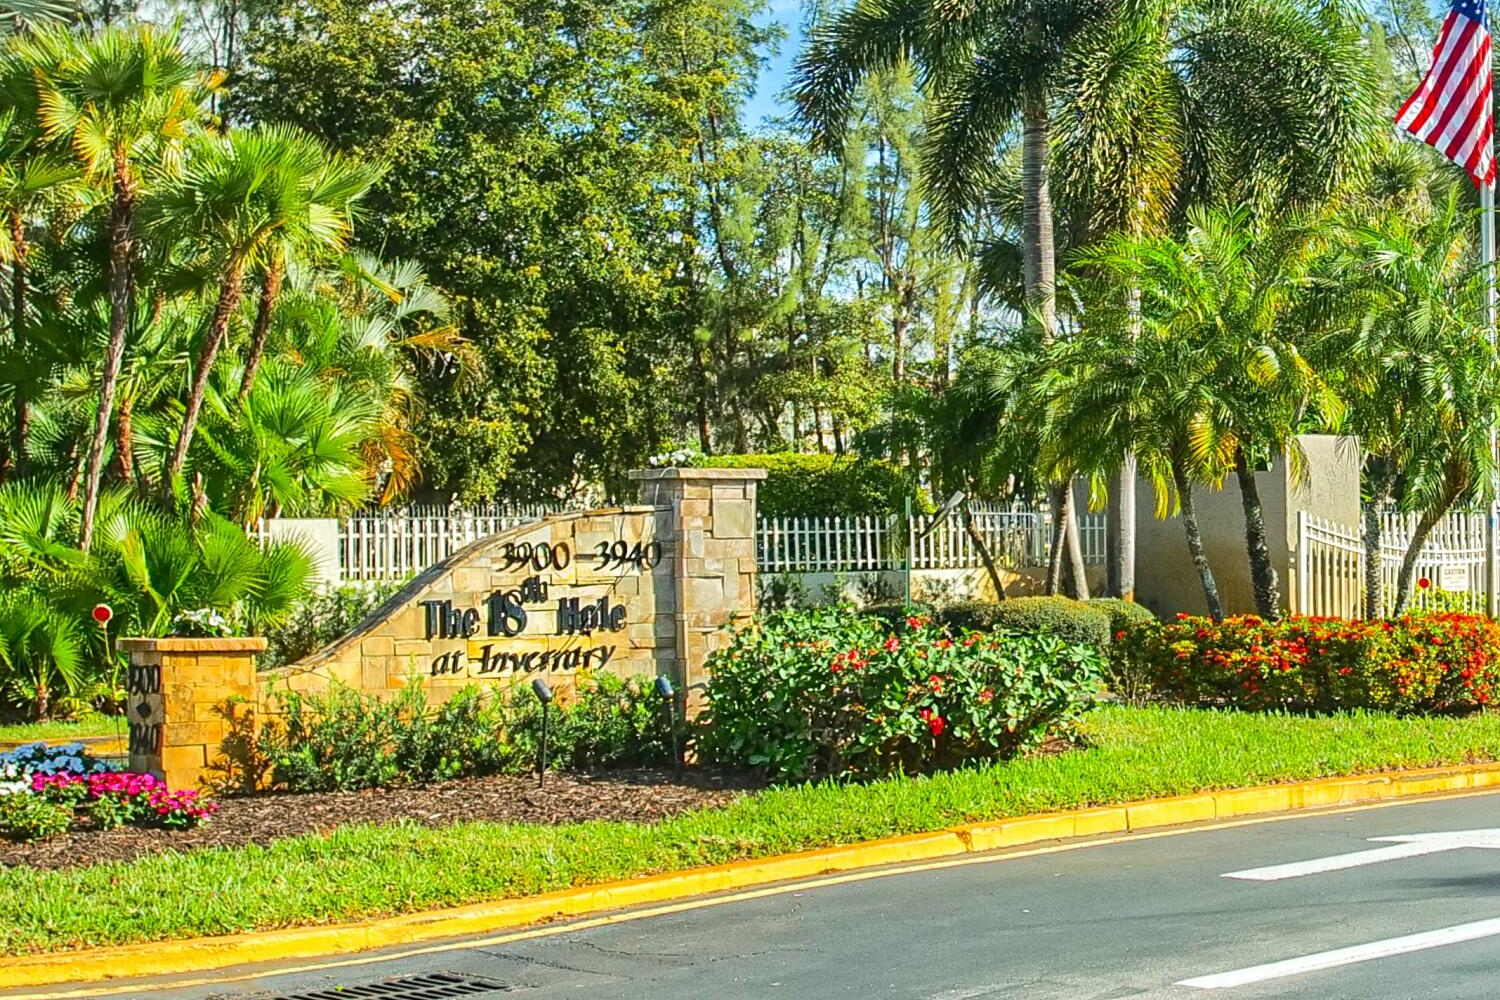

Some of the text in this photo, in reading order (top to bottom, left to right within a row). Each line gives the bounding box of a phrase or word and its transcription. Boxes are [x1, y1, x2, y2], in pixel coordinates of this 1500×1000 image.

[420, 600, 480, 639] The
[557, 595, 627, 635] Hole
[431, 643, 617, 676] at Inverrary
